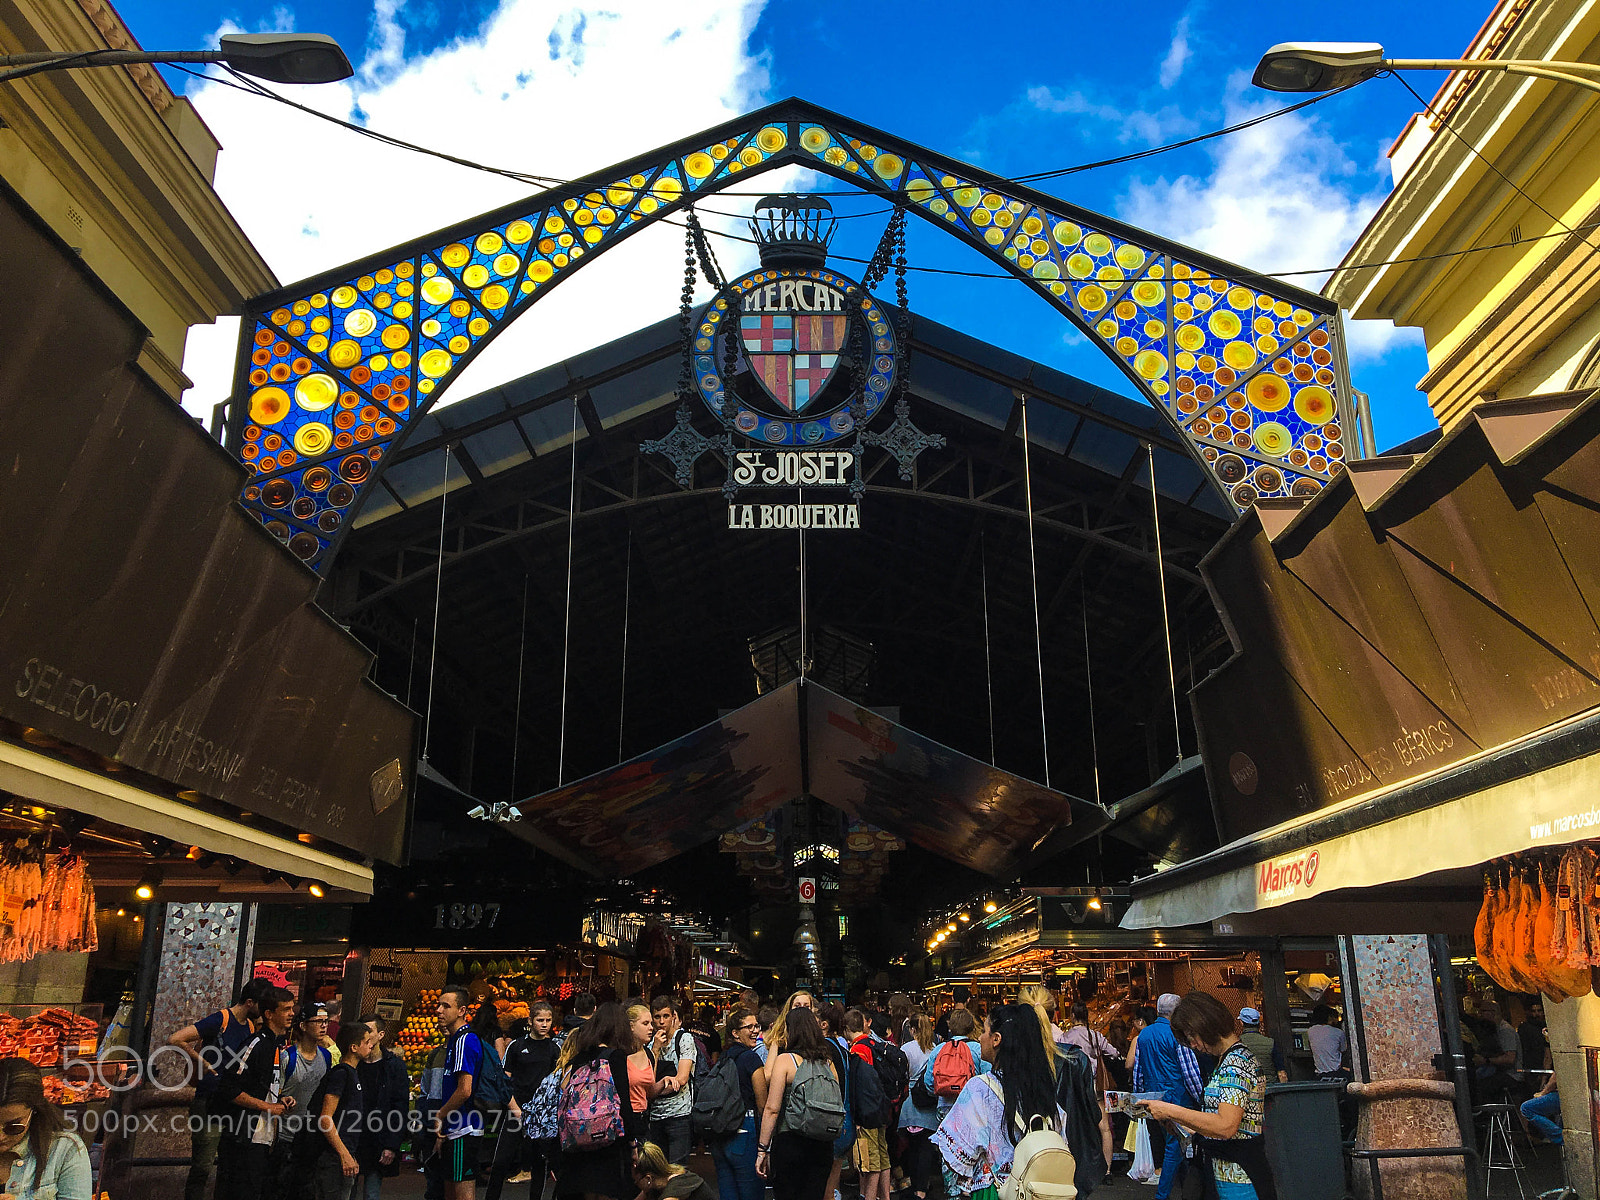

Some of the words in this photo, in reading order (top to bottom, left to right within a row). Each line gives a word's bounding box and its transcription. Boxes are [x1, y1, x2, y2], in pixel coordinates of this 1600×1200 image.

[744, 280, 845, 312] MERCAT
[761, 452, 854, 485] JOSEP
[728, 504, 755, 529] LA
[760, 504, 860, 529] BOQUERIA
[804, 884, 811, 897] 6
[1258, 860, 1304, 895] Marcos
[432, 902, 500, 930] 1897
[255, 970, 282, 982] NATURAL
